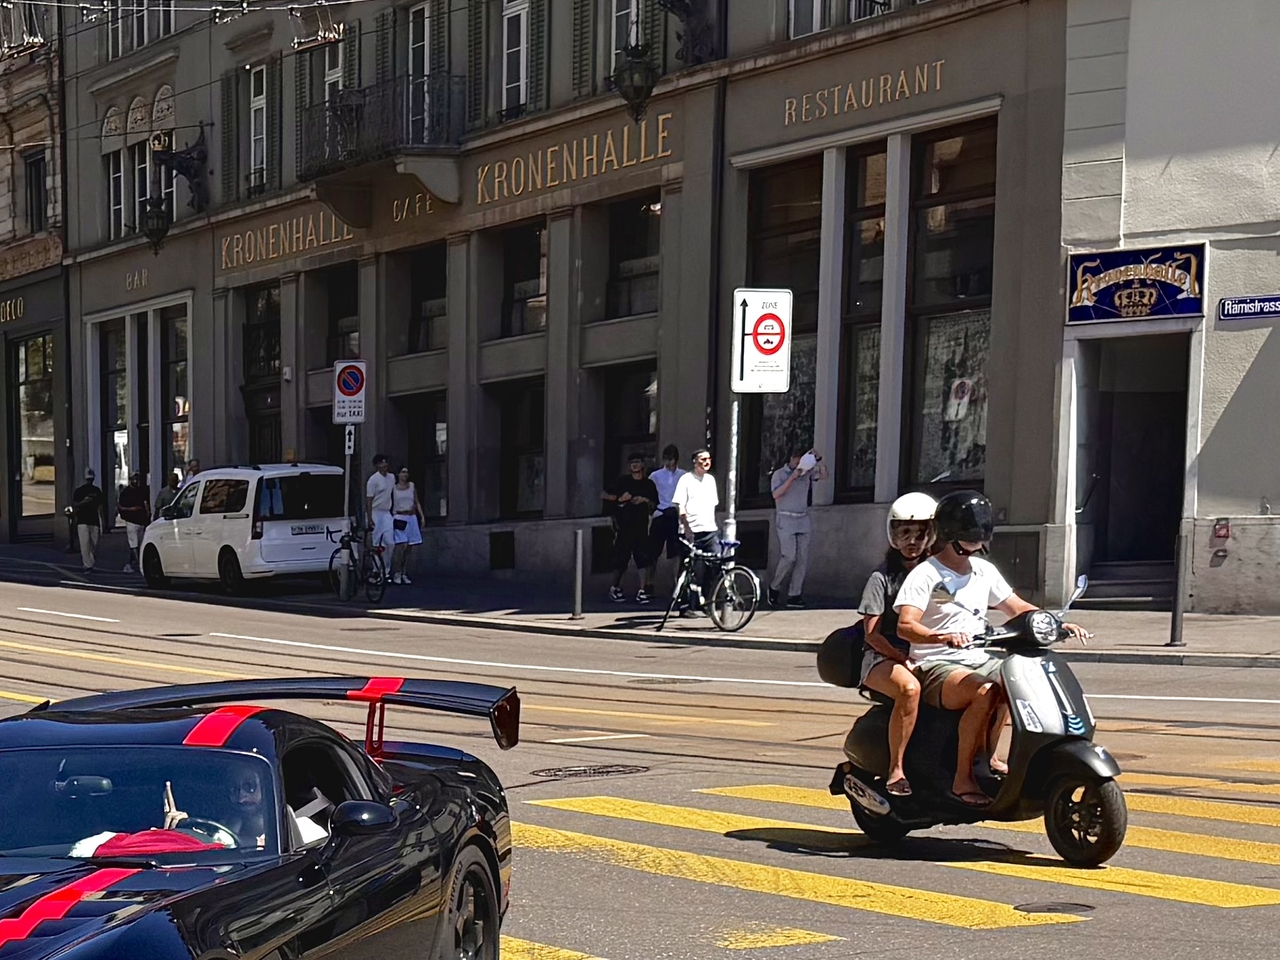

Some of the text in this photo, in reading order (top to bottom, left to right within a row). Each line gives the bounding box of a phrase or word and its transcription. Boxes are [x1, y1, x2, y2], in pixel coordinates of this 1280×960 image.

[784, 59, 946, 127] RESTAURANT
[476, 112, 673, 205] KRONENHALLE
[126, 268, 148, 291] BAR
